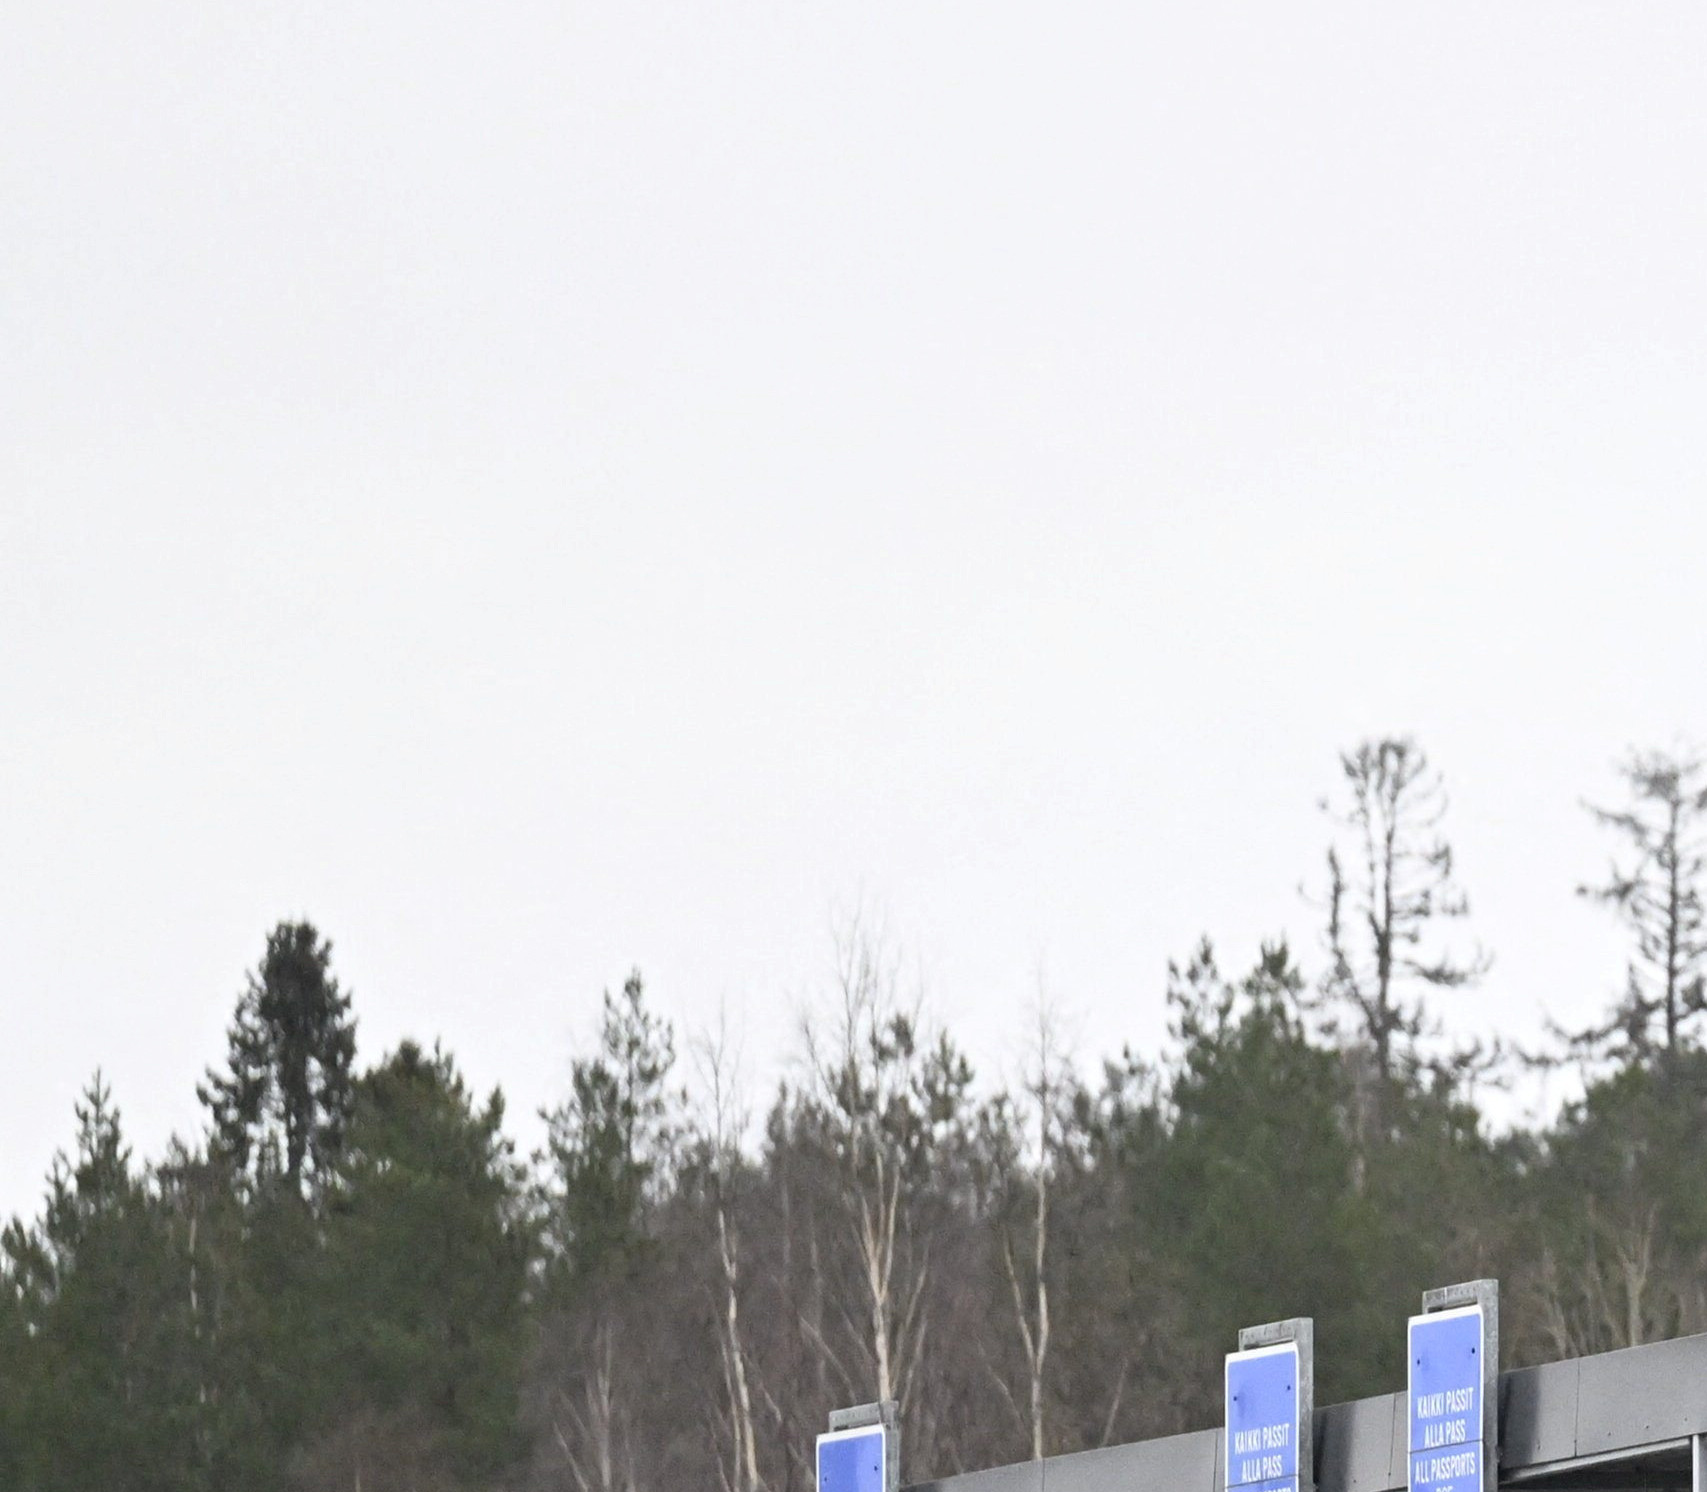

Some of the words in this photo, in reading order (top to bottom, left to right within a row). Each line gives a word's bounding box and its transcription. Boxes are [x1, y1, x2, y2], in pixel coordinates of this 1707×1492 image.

[1417, 1393, 1444, 1419] KAIKKI
[1445, 1387, 1474, 1413] PASSIT
[1234, 1430, 1260, 1455] KAIKKI
[1262, 1423, 1290, 1449] PASSIT
[1423, 1424, 1444, 1449] ALLA
[1446, 1418, 1466, 1444] PASS
[1241, 1459, 1260, 1481] ALLA
[1262, 1455, 1282, 1479] PASS
[1414, 1460, 1430, 1484] ALL
[1431, 1451, 1476, 1481] PASSPORTS
